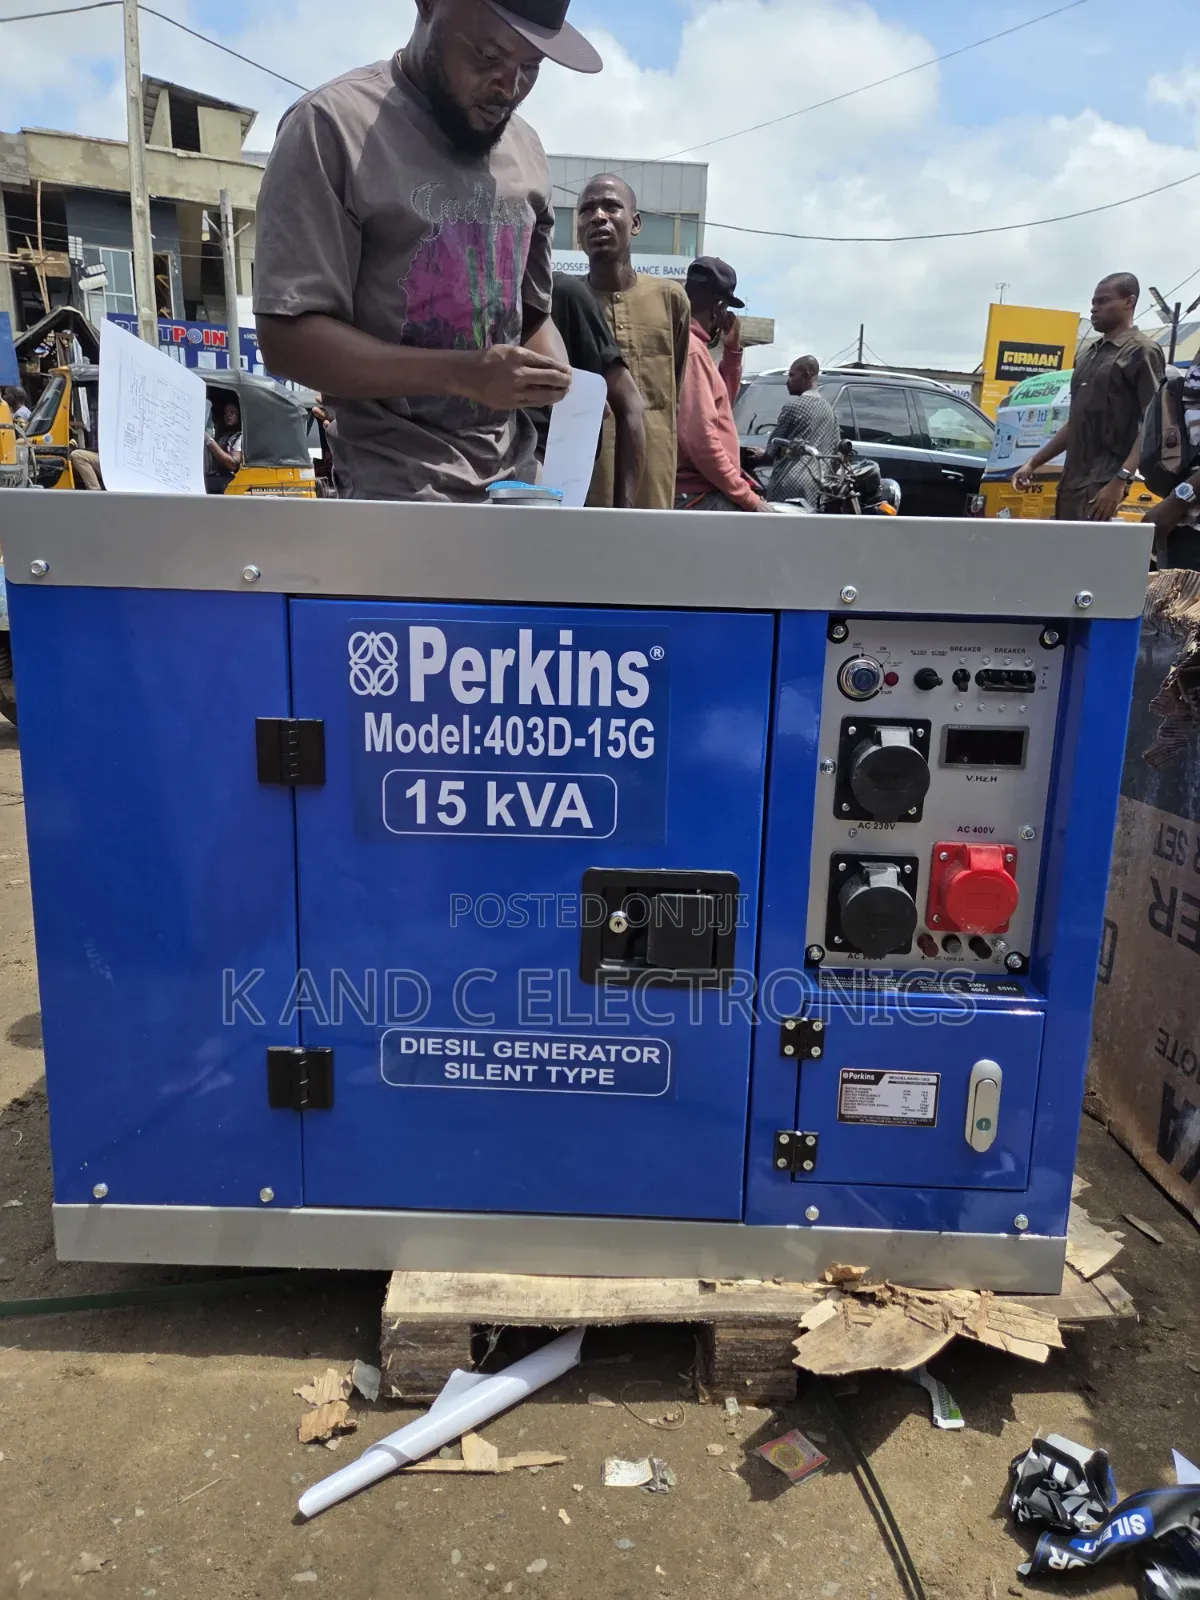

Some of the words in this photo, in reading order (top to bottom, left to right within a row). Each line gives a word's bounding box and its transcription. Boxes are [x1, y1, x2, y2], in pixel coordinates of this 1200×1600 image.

[663, 266, 687, 275] BANK
[1003, 351, 1059, 367] FIRMAN
[949, 645, 982, 653] BREAKER
[993, 647, 1026, 655] BREAKER
[364, 711, 655, 759] Model:403D-15G
[965, 774, 998, 783] V.Hz.H
[405, 779, 467, 826] 15
[487, 781, 594, 828] kVA
[857, 821, 872, 830] AC
[873, 822, 896, 831] 230V
[956, 825, 970, 834] AC
[972, 826, 996, 835] 400V
[1152, 822, 1188, 867] SET
[400, 1036, 485, 1058] DIESIL
[492, 1040, 662, 1065] GENERATOR
[443, 1062, 539, 1082] SILENT
[545, 1065, 616, 1086] TYPE
[848, 1072, 875, 1081] Perkins
